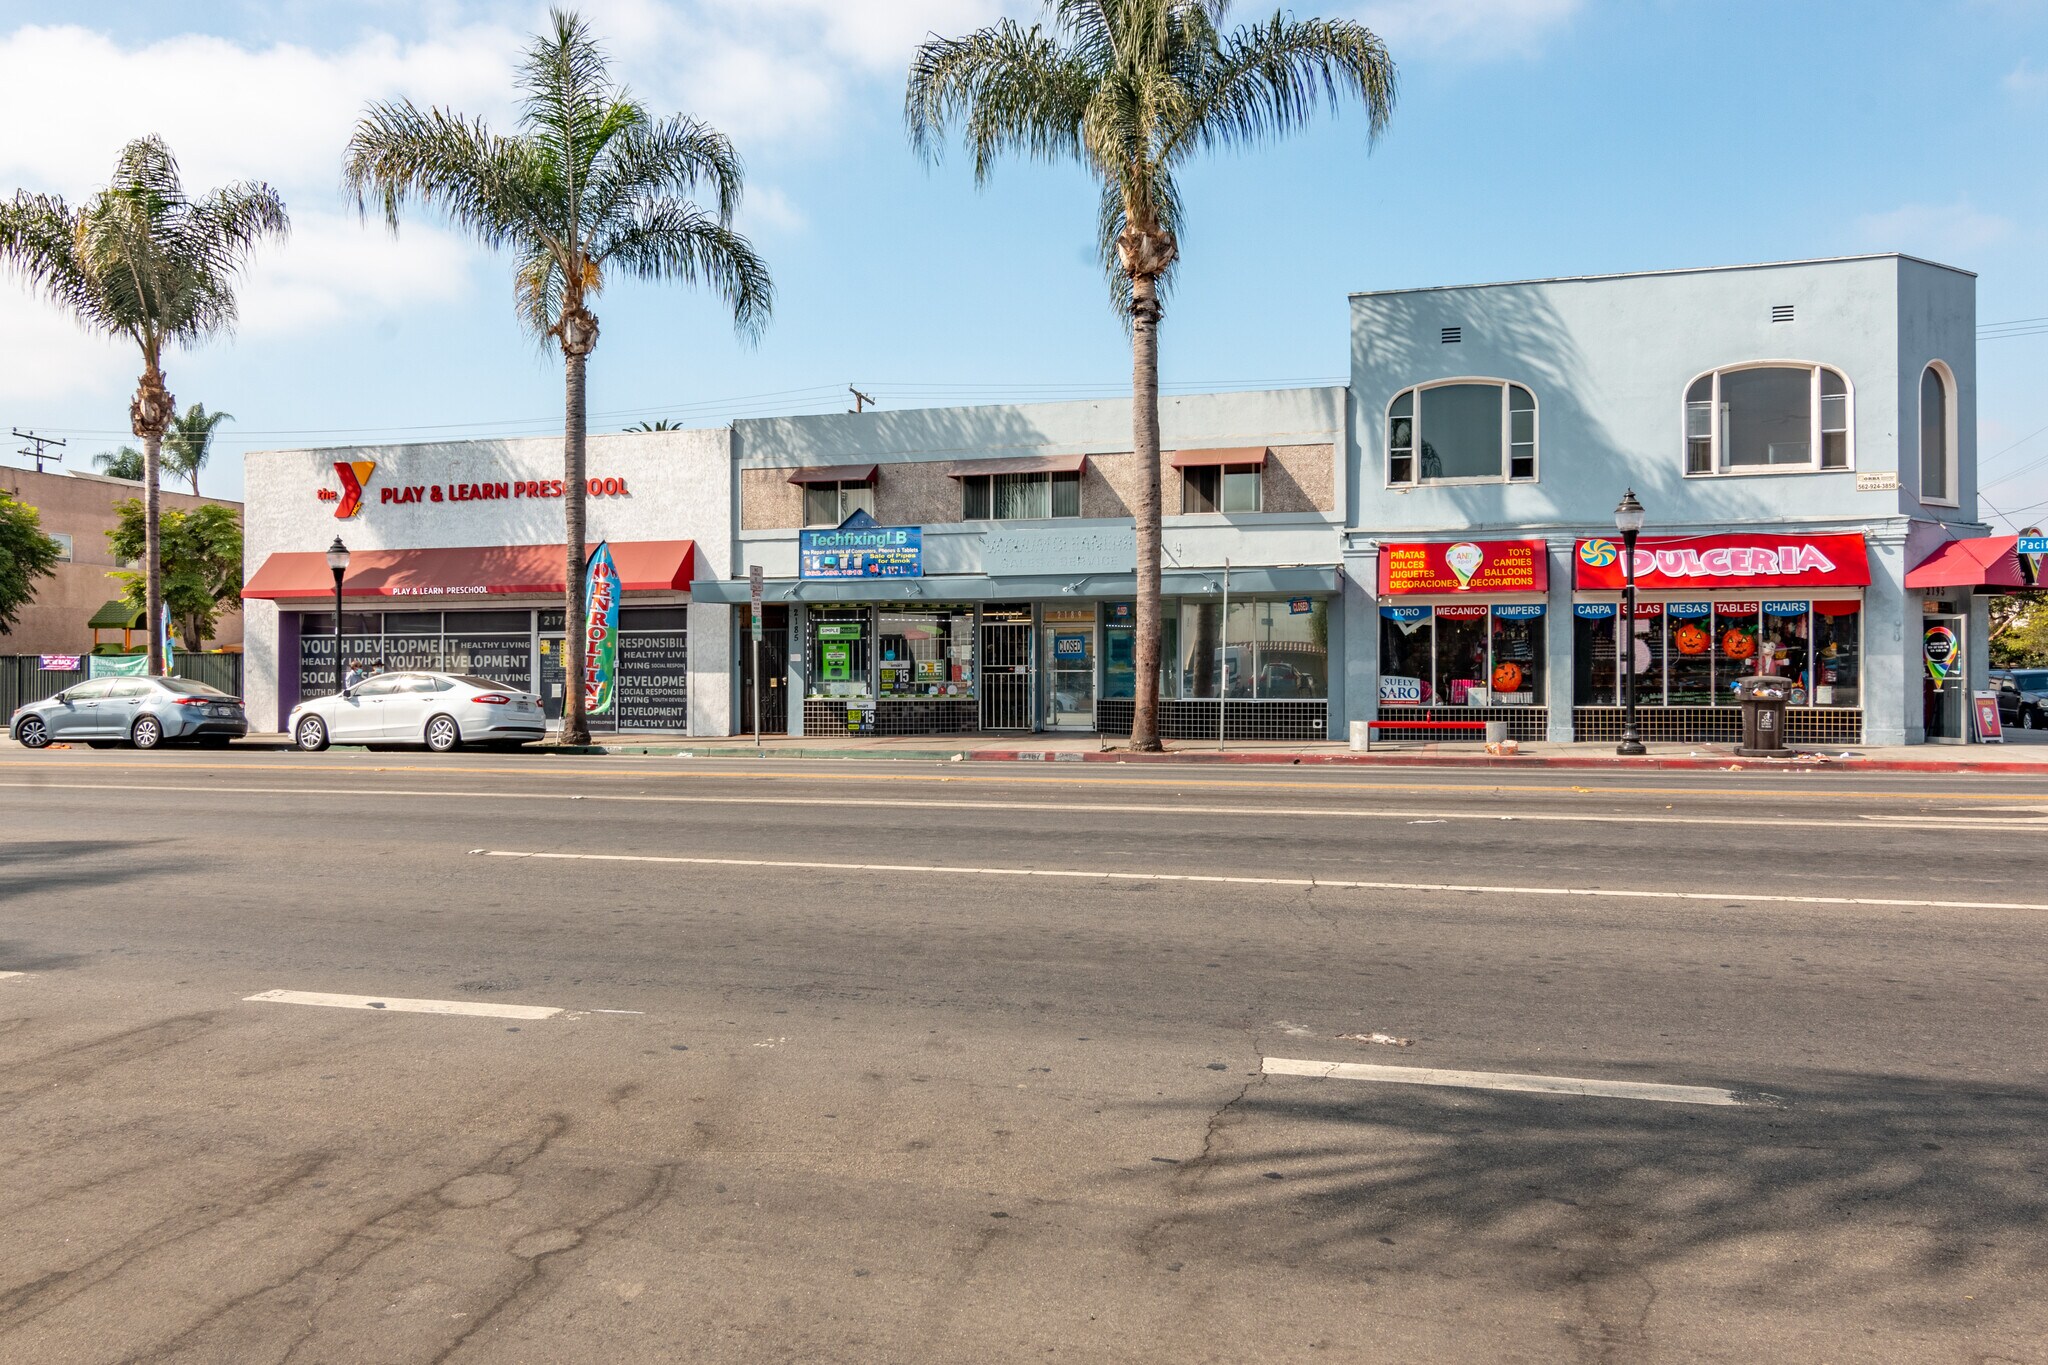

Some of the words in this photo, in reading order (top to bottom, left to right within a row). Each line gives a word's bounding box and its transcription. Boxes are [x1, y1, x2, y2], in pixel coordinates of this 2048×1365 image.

[317, 488, 337, 500] the
[381, 486, 425, 504] PLAY
[430, 485, 443, 502] &
[449, 483, 508, 501] LEARN
[514, 477, 628, 499] PRESOOL
[810, 531, 907, 548] TechfixingLB
[1390, 550, 1425, 560] PIÑATAS
[1508, 548, 1532, 557] TOYS
[1390, 560, 1425, 569] DULCES
[1493, 558, 1532, 567] CANDIES
[1618, 543, 1837, 578] DULCERIA
[1390, 570, 1435, 579] JUGUETES
[1484, 567, 1533, 577] BALLOONS
[1389, 579, 1459, 589] DECORACIONES
[1470, 577, 1533, 587] DECORATIONS
[393, 587, 410, 595] PLAY
[412, 587, 418, 595] &
[420, 586, 443, 595] LEARN
[446, 585, 488, 594] PRESCHOOL
[1394, 608, 1420, 616] TORO
[1436, 606, 1488, 615] MECANICO
[1496, 606, 1541, 615] JUMPERS
[1577, 605, 1611, 614] CARPA
[1622, 604, 1661, 614] SLLAS
[1669, 604, 1708, 613] MESAS
[1716, 603, 1758, 613] TABLES
[1765, 602, 1807, 612] CHAIRS
[1057, 611, 1082, 620] 2189
[543, 616, 566, 626] 217
[355, 639, 459, 653] DEVELOPMENT
[461, 641, 500, 649] HEALTHY
[502, 641, 531, 649] LIVING
[585, 582, 611, 711] ENROLLING
[1059, 640, 1082, 653] CLOSED
[624, 651, 665, 659] HEALTHY
[668, 651, 687, 659] LIVI
[389, 655, 432, 668] YOUTH
[436, 655, 528, 668] DEVELOPMENT
[918, 662, 942, 673] DEE
[302, 672, 343, 684] SOCIA
[496, 673, 531, 682] LIVING
[620, 675, 687, 687] DEVELOPME
[896, 669, 909, 683] $15
[1385, 678, 1413, 686] SUELY
[646, 688, 687, 696] RESPONSIBI
[1380, 686, 1420, 699] SARO
[620, 696, 649, 704] LIVING
[621, 707, 683, 716] DEVELOPMENT
[862, 710, 875, 724] $15
[620, 719, 664, 727] HEALTHY
[667, 719, 687, 727] LIVI
